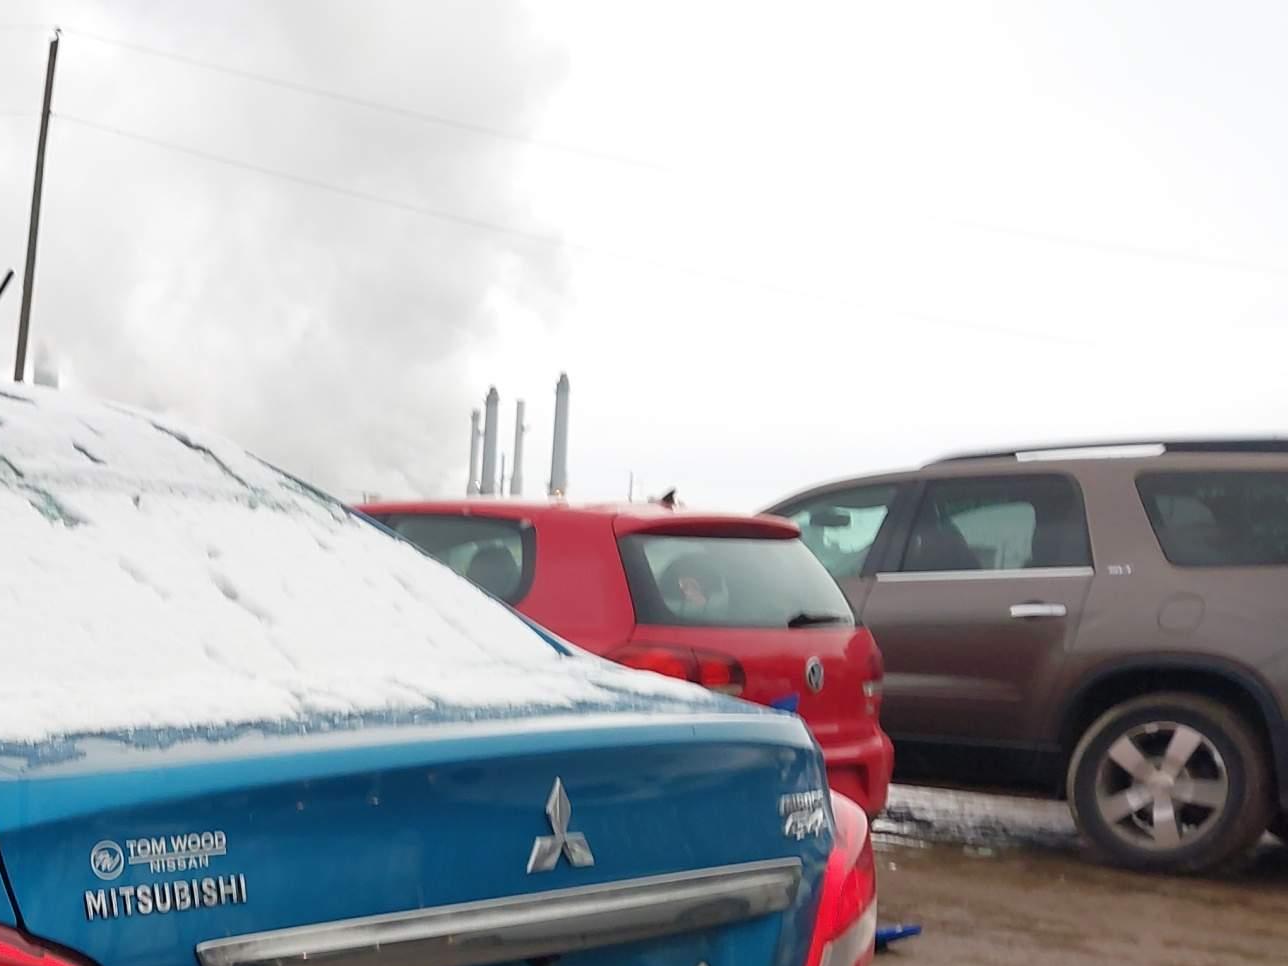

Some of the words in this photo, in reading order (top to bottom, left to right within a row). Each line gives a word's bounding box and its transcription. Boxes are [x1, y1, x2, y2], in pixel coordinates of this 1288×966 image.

[126, 835, 167, 858] TOM
[170, 830, 227, 854] WOOD
[149, 854, 209, 874] NISSAN
[84, 872, 248, 921] MITSUBISHI
